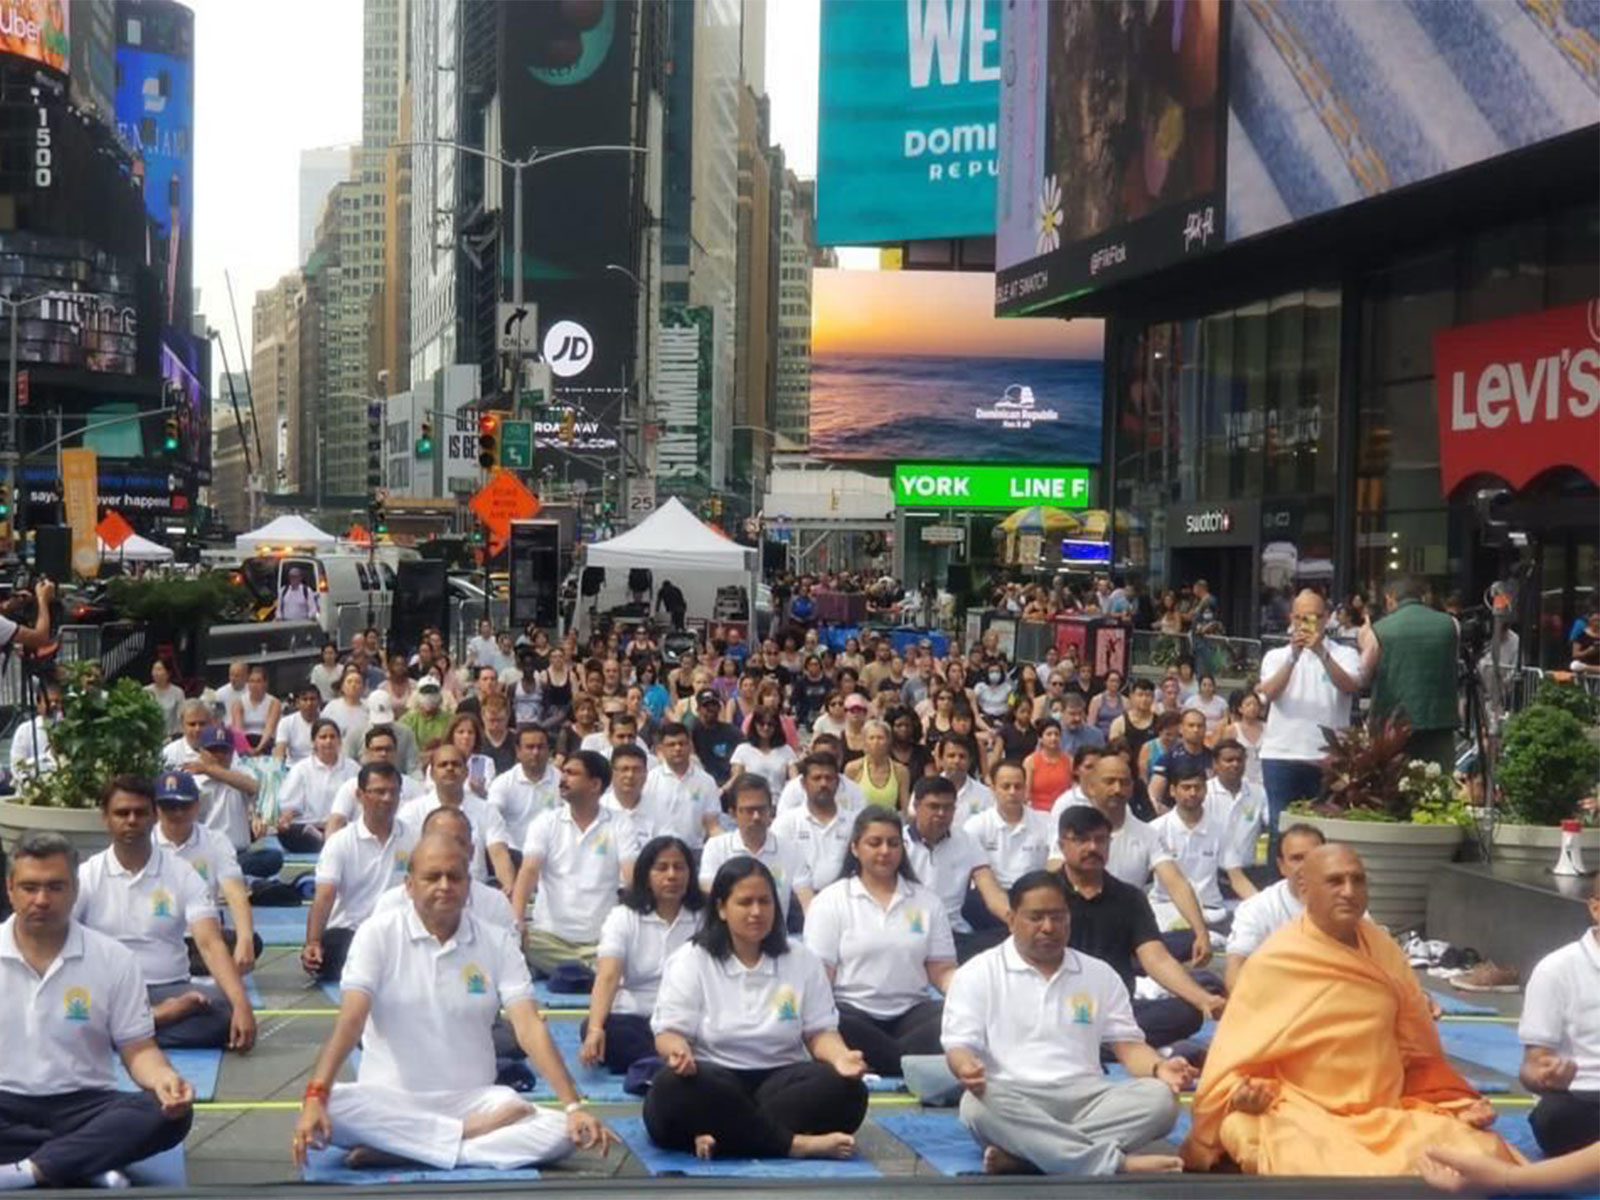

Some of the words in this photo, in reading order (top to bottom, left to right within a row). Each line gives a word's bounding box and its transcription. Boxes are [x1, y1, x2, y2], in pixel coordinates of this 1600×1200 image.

[36, 107, 51, 187] 1500
[552, 336, 588, 361] JD
[901, 476, 970, 497] YORK
[1010, 478, 1065, 498] LINE
[1072, 479, 1089, 498] F
[632, 497, 652, 510] 25
[1186, 510, 1223, 532] swatch
